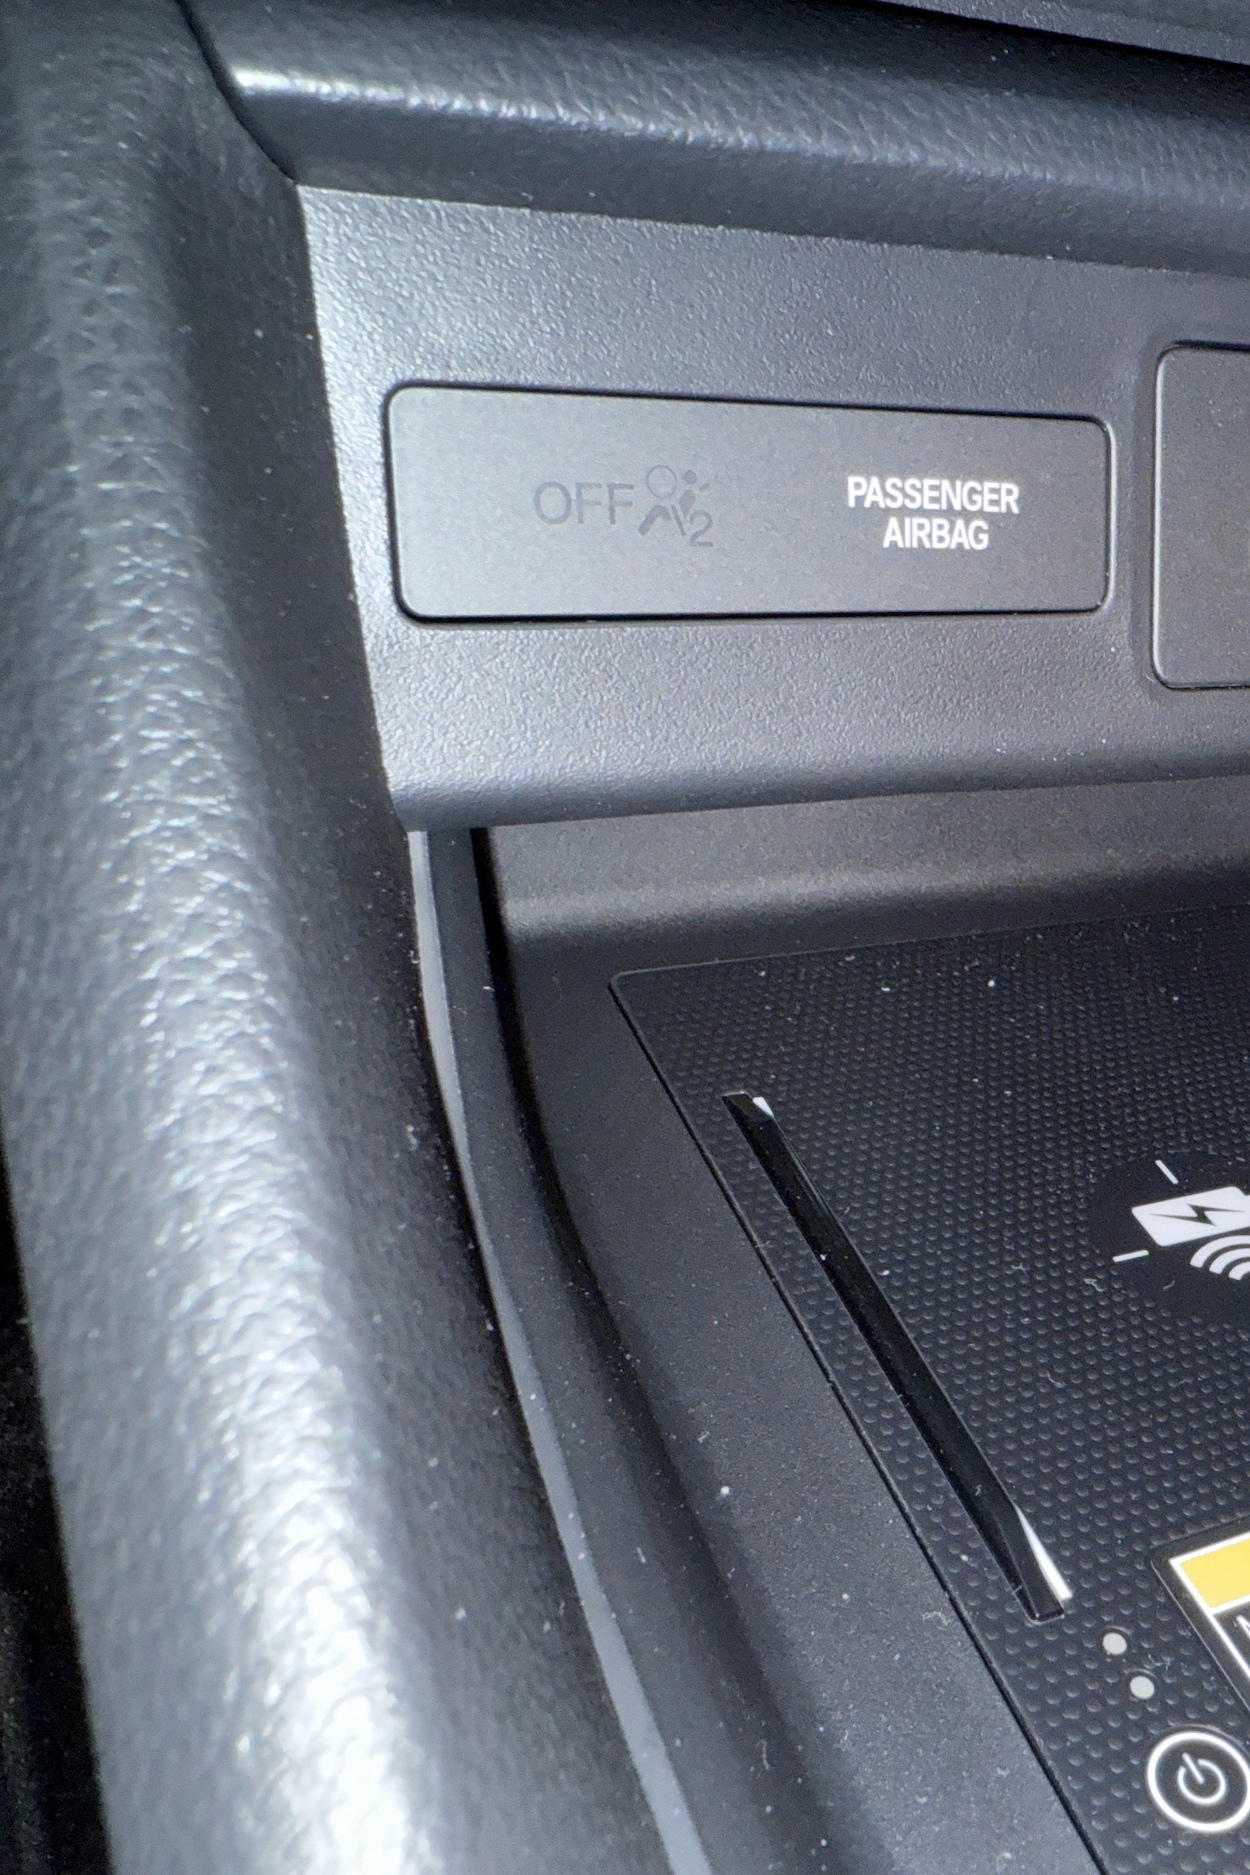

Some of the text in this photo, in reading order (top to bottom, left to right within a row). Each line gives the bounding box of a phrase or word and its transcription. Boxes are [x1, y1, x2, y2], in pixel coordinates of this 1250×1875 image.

[533, 481, 634, 525] OFF
[848, 476, 1020, 514] PASSENGER
[883, 517, 989, 550] AIRBAG
